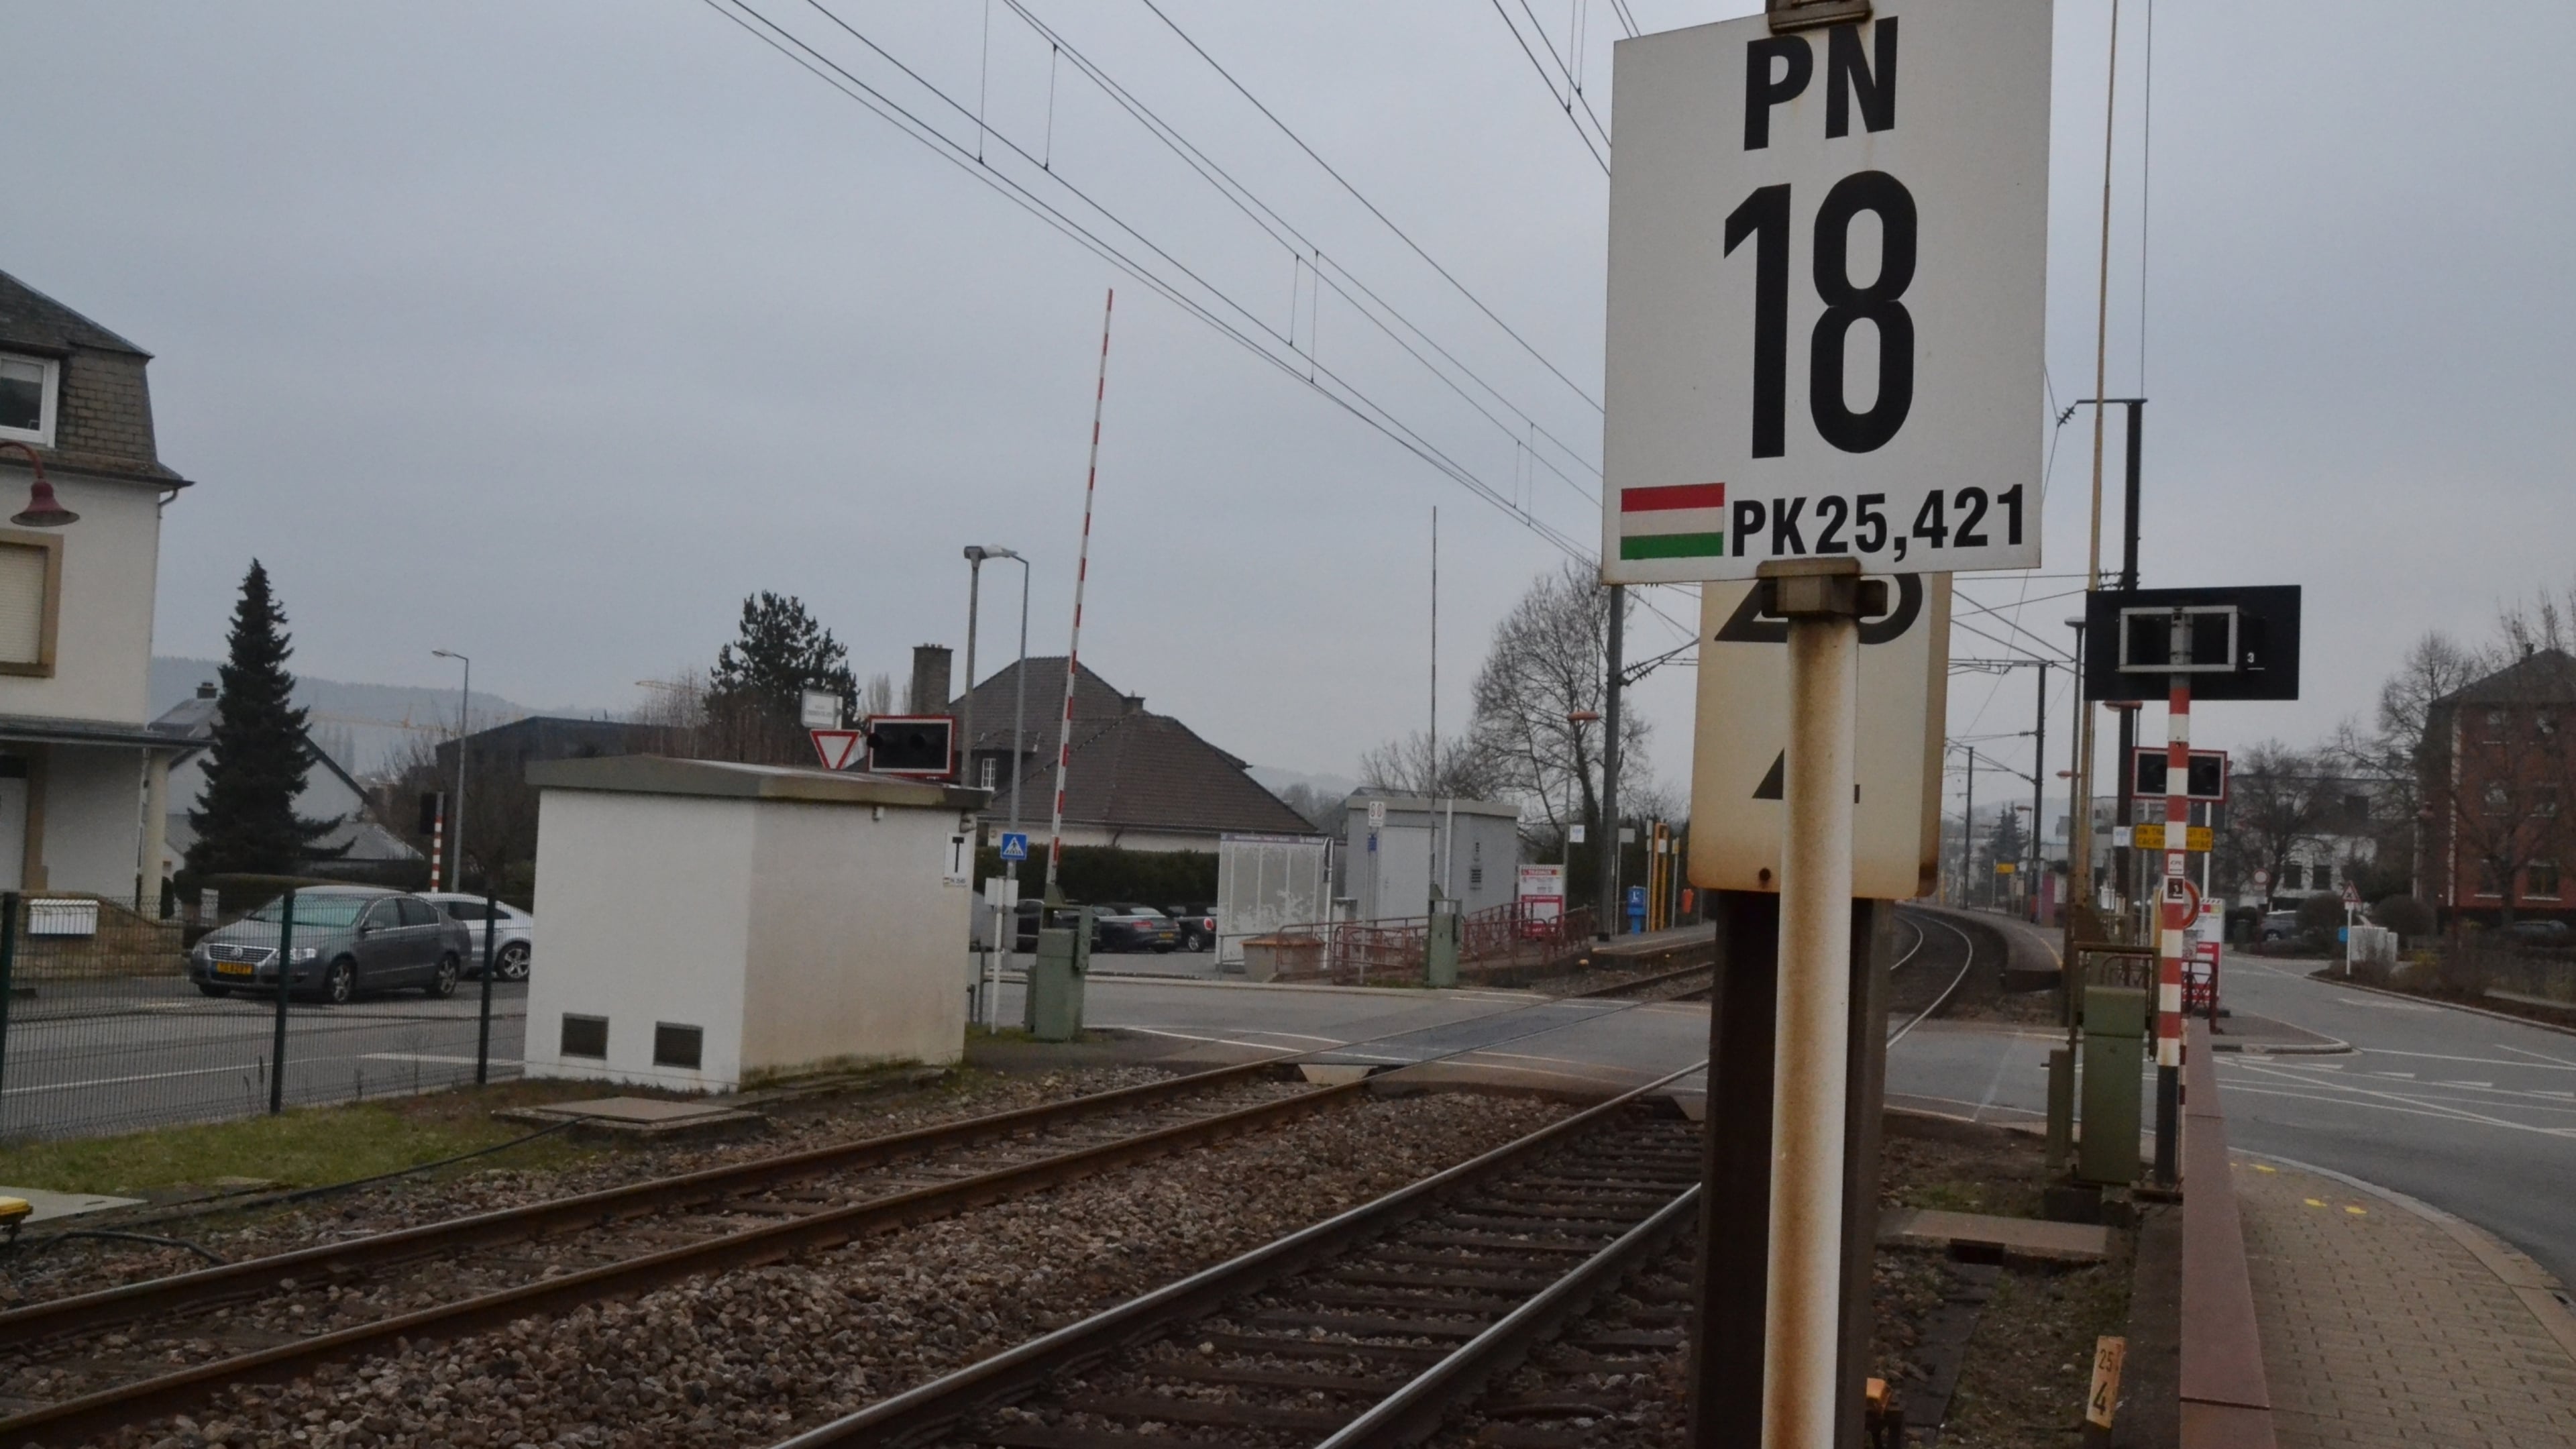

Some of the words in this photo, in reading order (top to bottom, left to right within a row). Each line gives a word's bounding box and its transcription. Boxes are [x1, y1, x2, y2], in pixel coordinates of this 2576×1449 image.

[1743, 16, 1898, 151] PN
[1723, 170, 1918, 459] 18
[1731, 484, 2023, 562] PK25,421
[2247, 652, 2255, 663] 3
[2098, 1348, 2114, 1372] 25
[2093, 1381, 2108, 1415] 4
